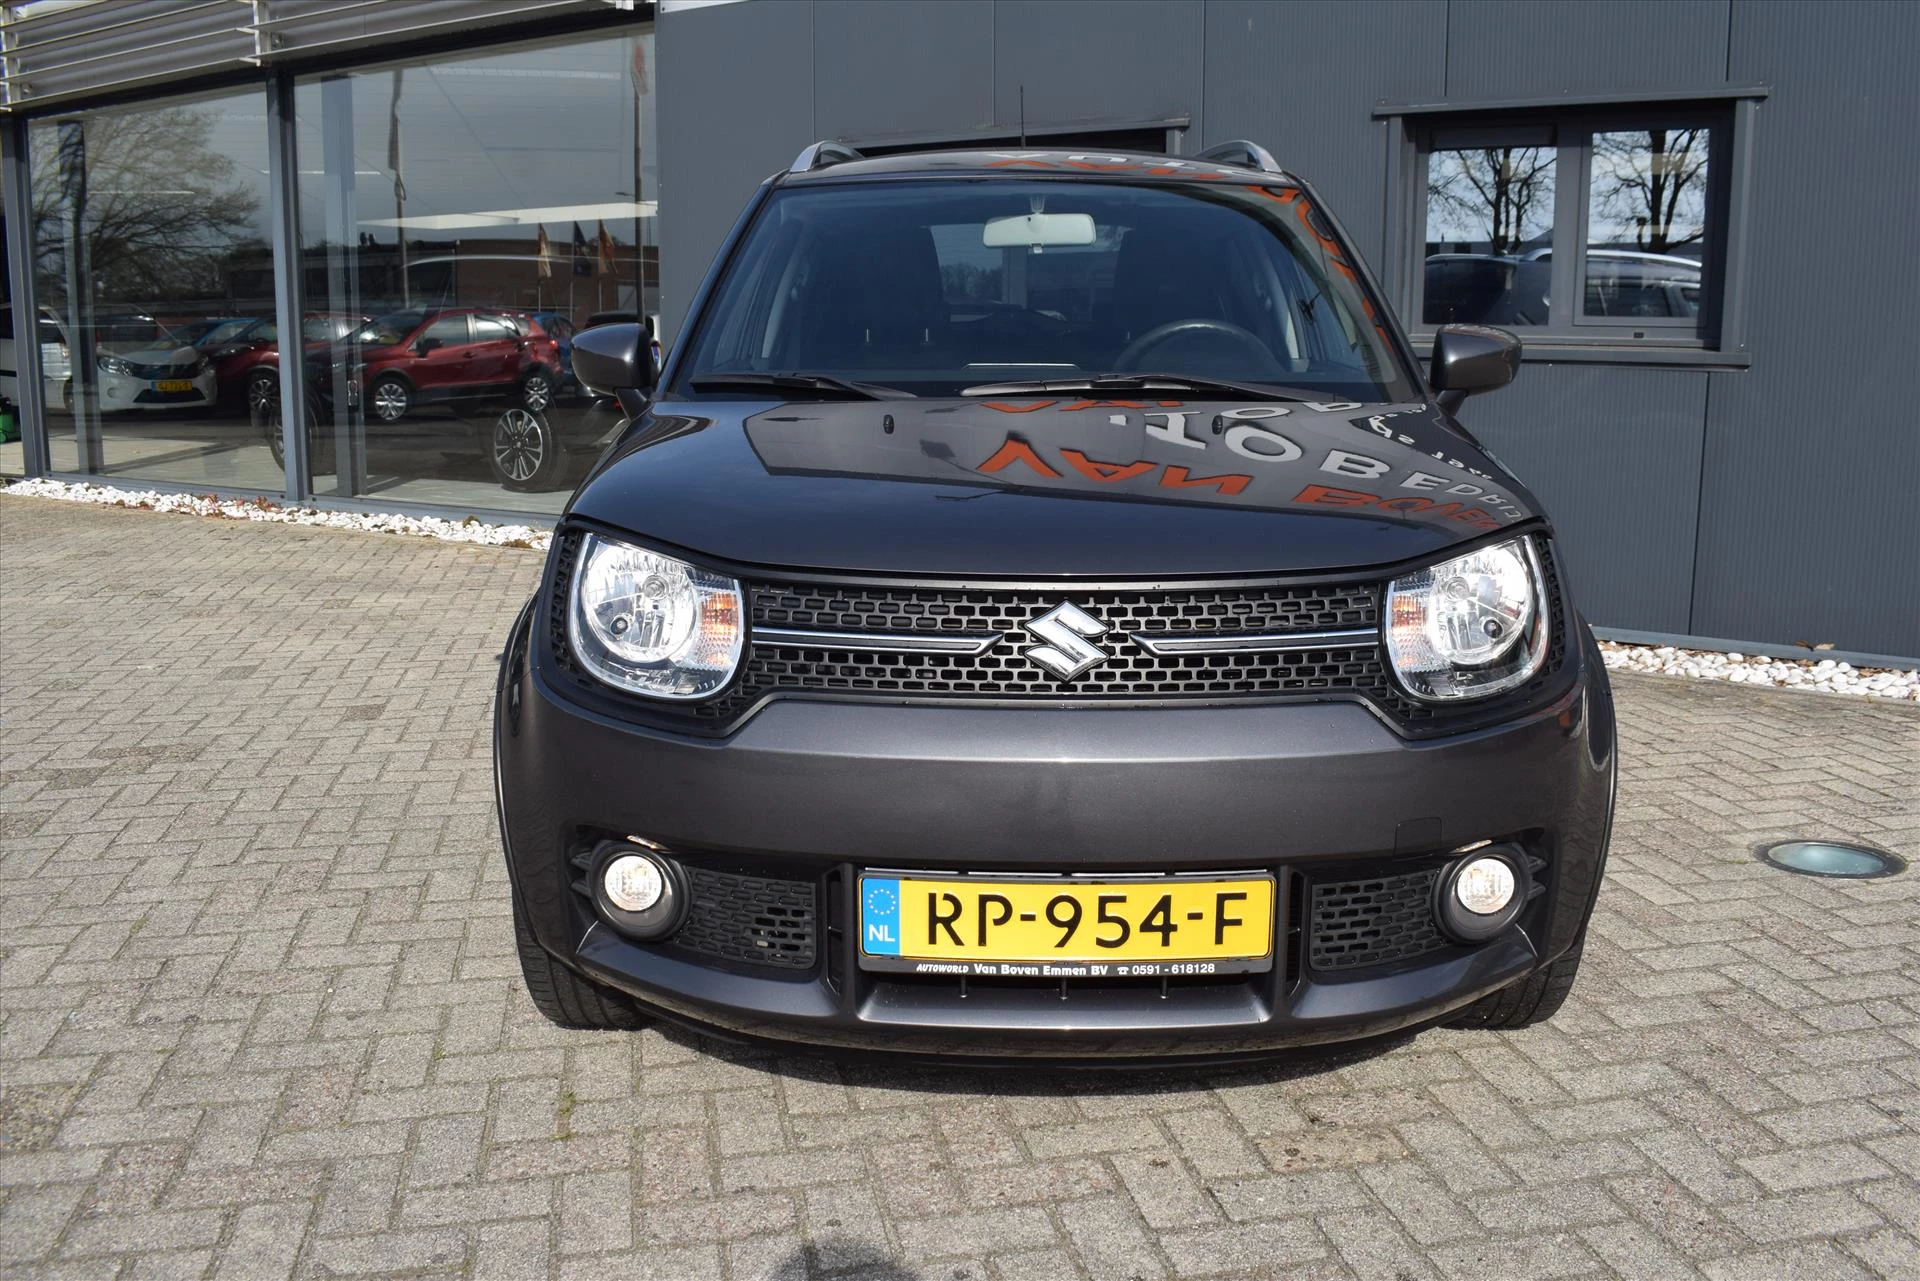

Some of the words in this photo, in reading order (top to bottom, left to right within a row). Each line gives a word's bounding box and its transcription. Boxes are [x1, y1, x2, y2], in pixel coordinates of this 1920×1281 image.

[927, 891, 1248, 949] RP-954-F
[868, 924, 896, 943] NL
[916, 963, 969, 974] AUTOWORLD
[974, 962, 997, 975] Van
[1000, 963, 1039, 976] Boven
[1043, 964, 1087, 977] Emmen
[1090, 964, 1109, 977] BV
[1132, 964, 1160, 976] 0591
[1171, 963, 1216, 975] 618128
